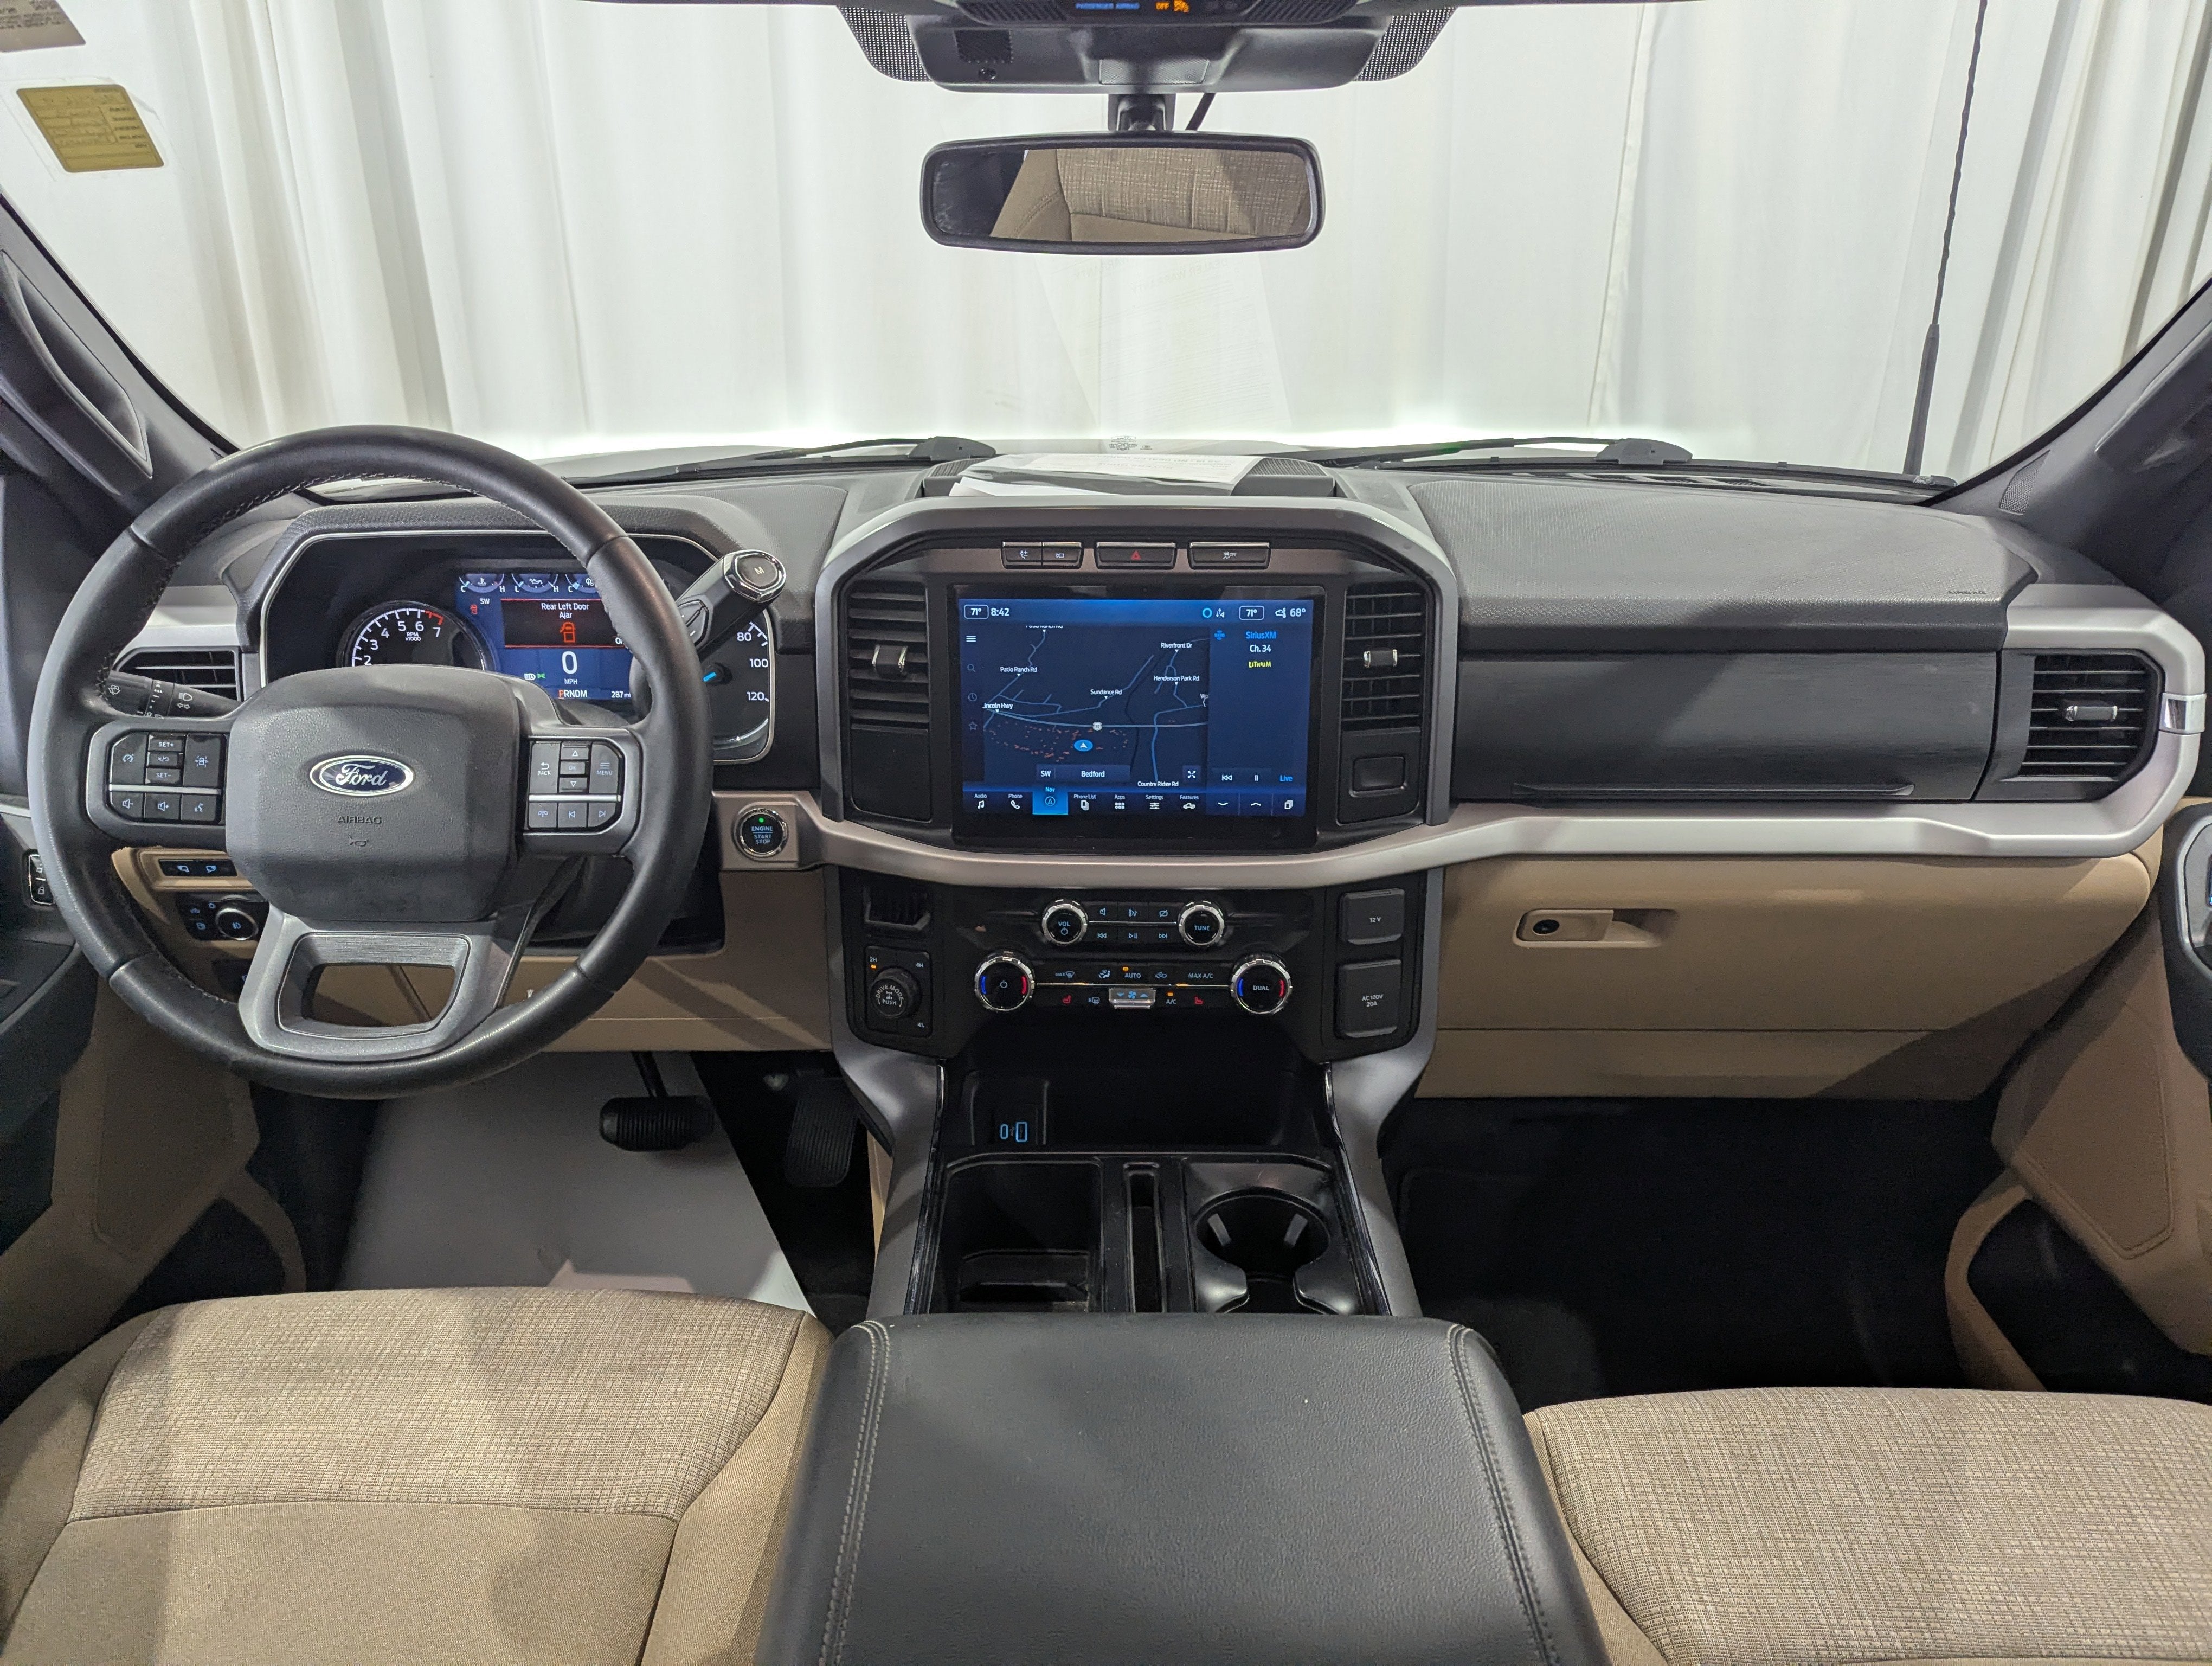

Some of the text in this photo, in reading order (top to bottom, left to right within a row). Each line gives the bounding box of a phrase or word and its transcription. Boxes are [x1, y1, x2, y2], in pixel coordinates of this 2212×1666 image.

[1156, 2, 1170, 10] OFF
[754, 566, 764, 575] M
[991, 607, 1009, 616] 8:42
[1246, 608, 1257, 617] 71°
[1290, 608, 1306, 617] 68°
[397, 621, 406, 631] 5
[415, 621, 424, 631] 6
[381, 628, 390, 638] 4
[433, 627, 441, 637] 7
[737, 632, 751, 641] 80
[1245, 631, 1276, 639] SiriusXM
[370, 639, 378, 650] 3
[1250, 644, 1261, 652] Ch.
[363, 655, 372, 665] 2
[562, 651, 577, 674] 0
[749, 658, 768, 668] 100
[558, 690, 587, 698] PRNDM
[747, 691, 764, 701] 120
[335, 763, 388, 786] Ford
[338, 815, 383, 824] AIRBAG
[876, 984, 904, 1001] DRIVE MODE
